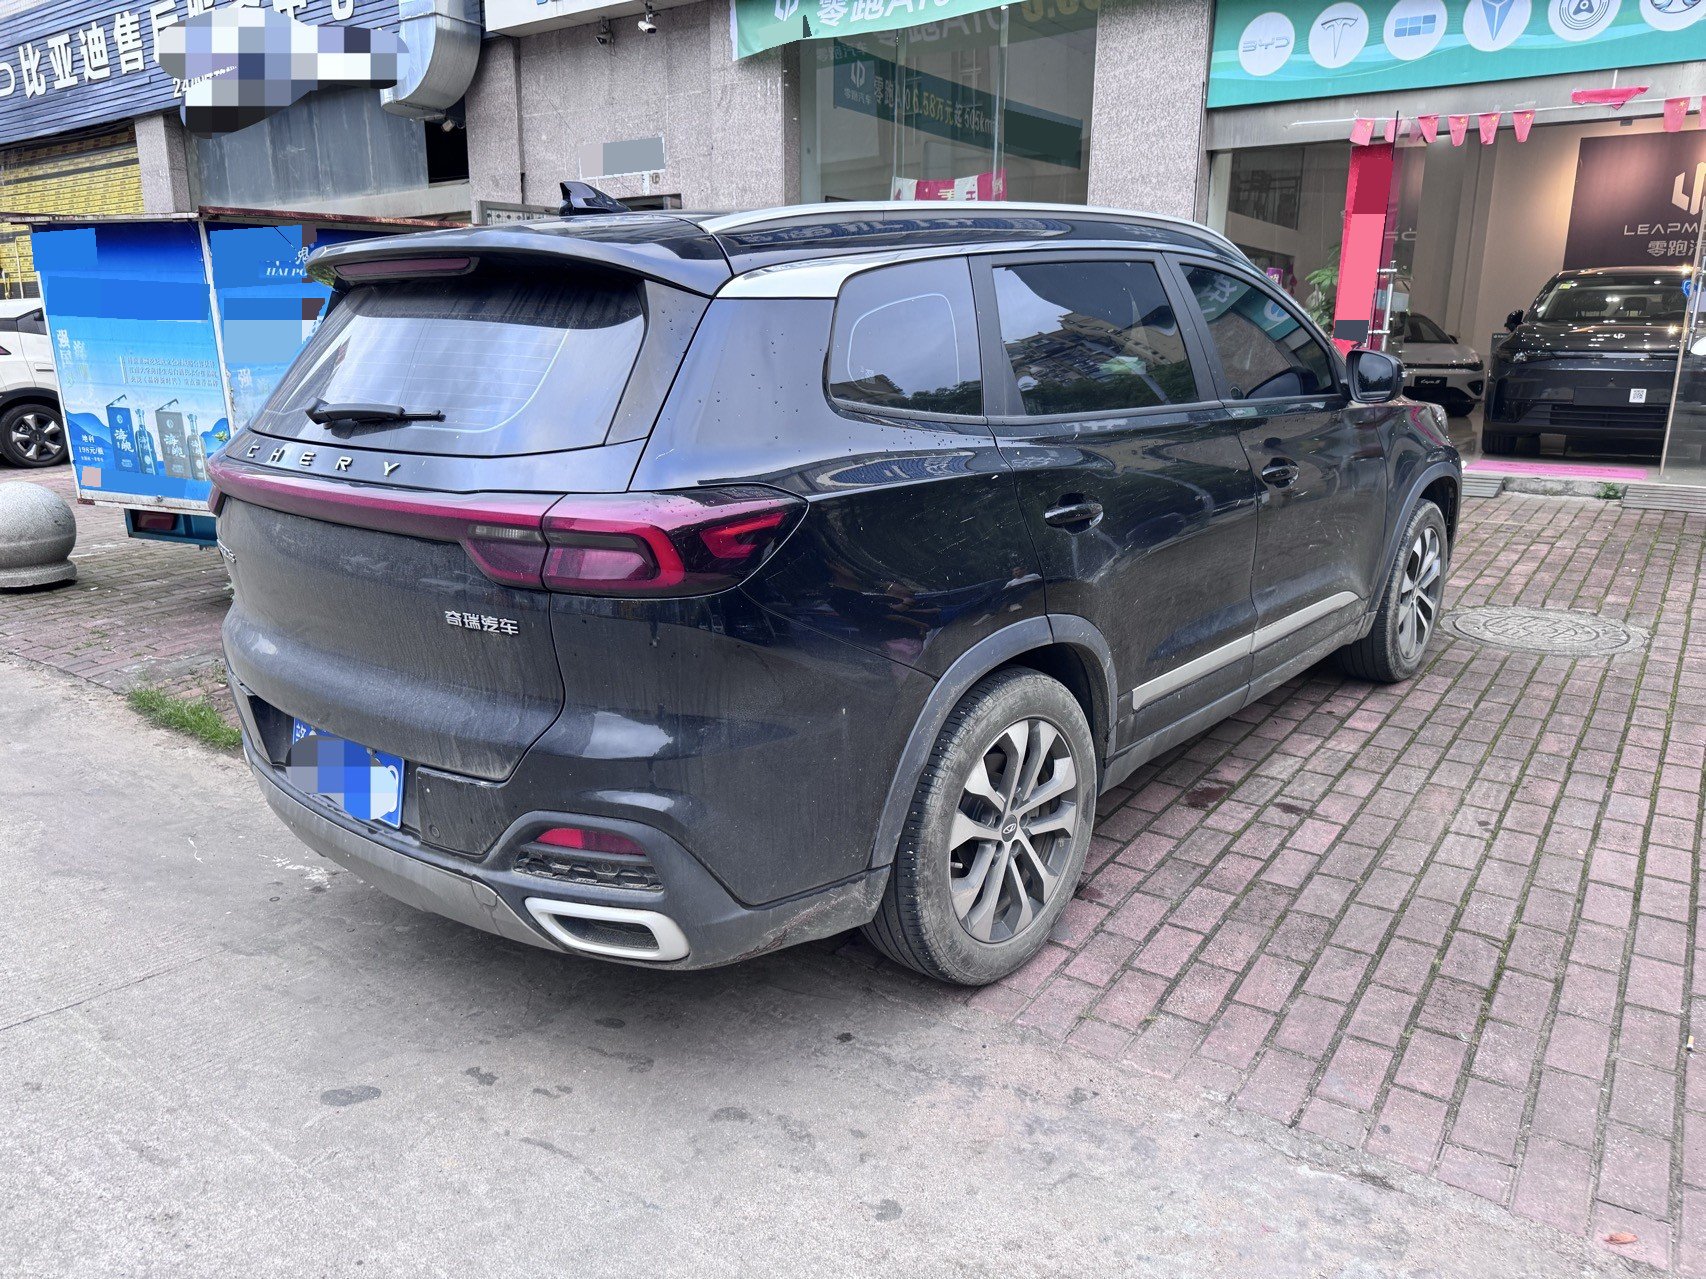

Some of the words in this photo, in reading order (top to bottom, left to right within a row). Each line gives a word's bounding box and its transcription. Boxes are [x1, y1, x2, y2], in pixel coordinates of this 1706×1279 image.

[1242, 36, 1290, 52] BYD
[1623, 222, 1706, 236] LEAPM
[246, 446, 400, 476] CHERY
[444, 610, 519, 636] 奇瑞汽车
